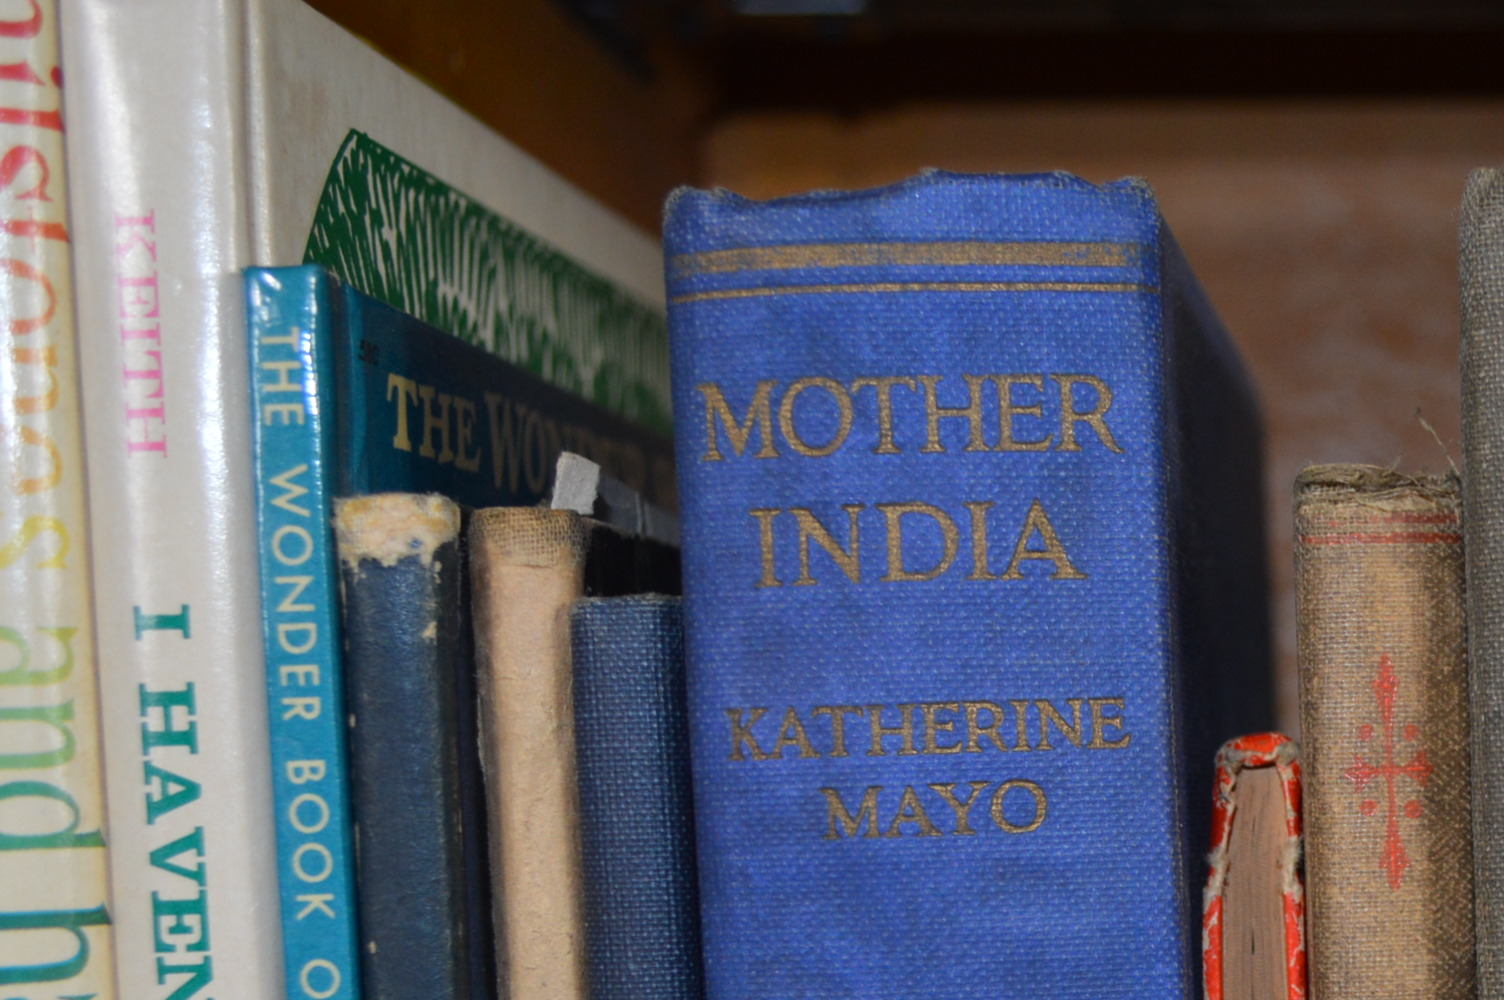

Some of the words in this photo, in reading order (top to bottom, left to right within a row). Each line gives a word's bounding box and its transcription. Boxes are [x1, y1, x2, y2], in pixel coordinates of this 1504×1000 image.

[115, 209, 168, 459] KEITH
[259, 326, 307, 427] THE
[386, 372, 482, 474] THE
[699, 373, 1126, 462] MOTHER
[267, 463, 322, 722] WONDER
[748, 498, 1090, 588] INDIA
[132, 603, 191, 641] I
[0, 624, 106, 852] and
[725, 697, 1132, 761] KATHERINE
[286, 757, 337, 921] BOOK
[820, 779, 1049, 841] MAYO
